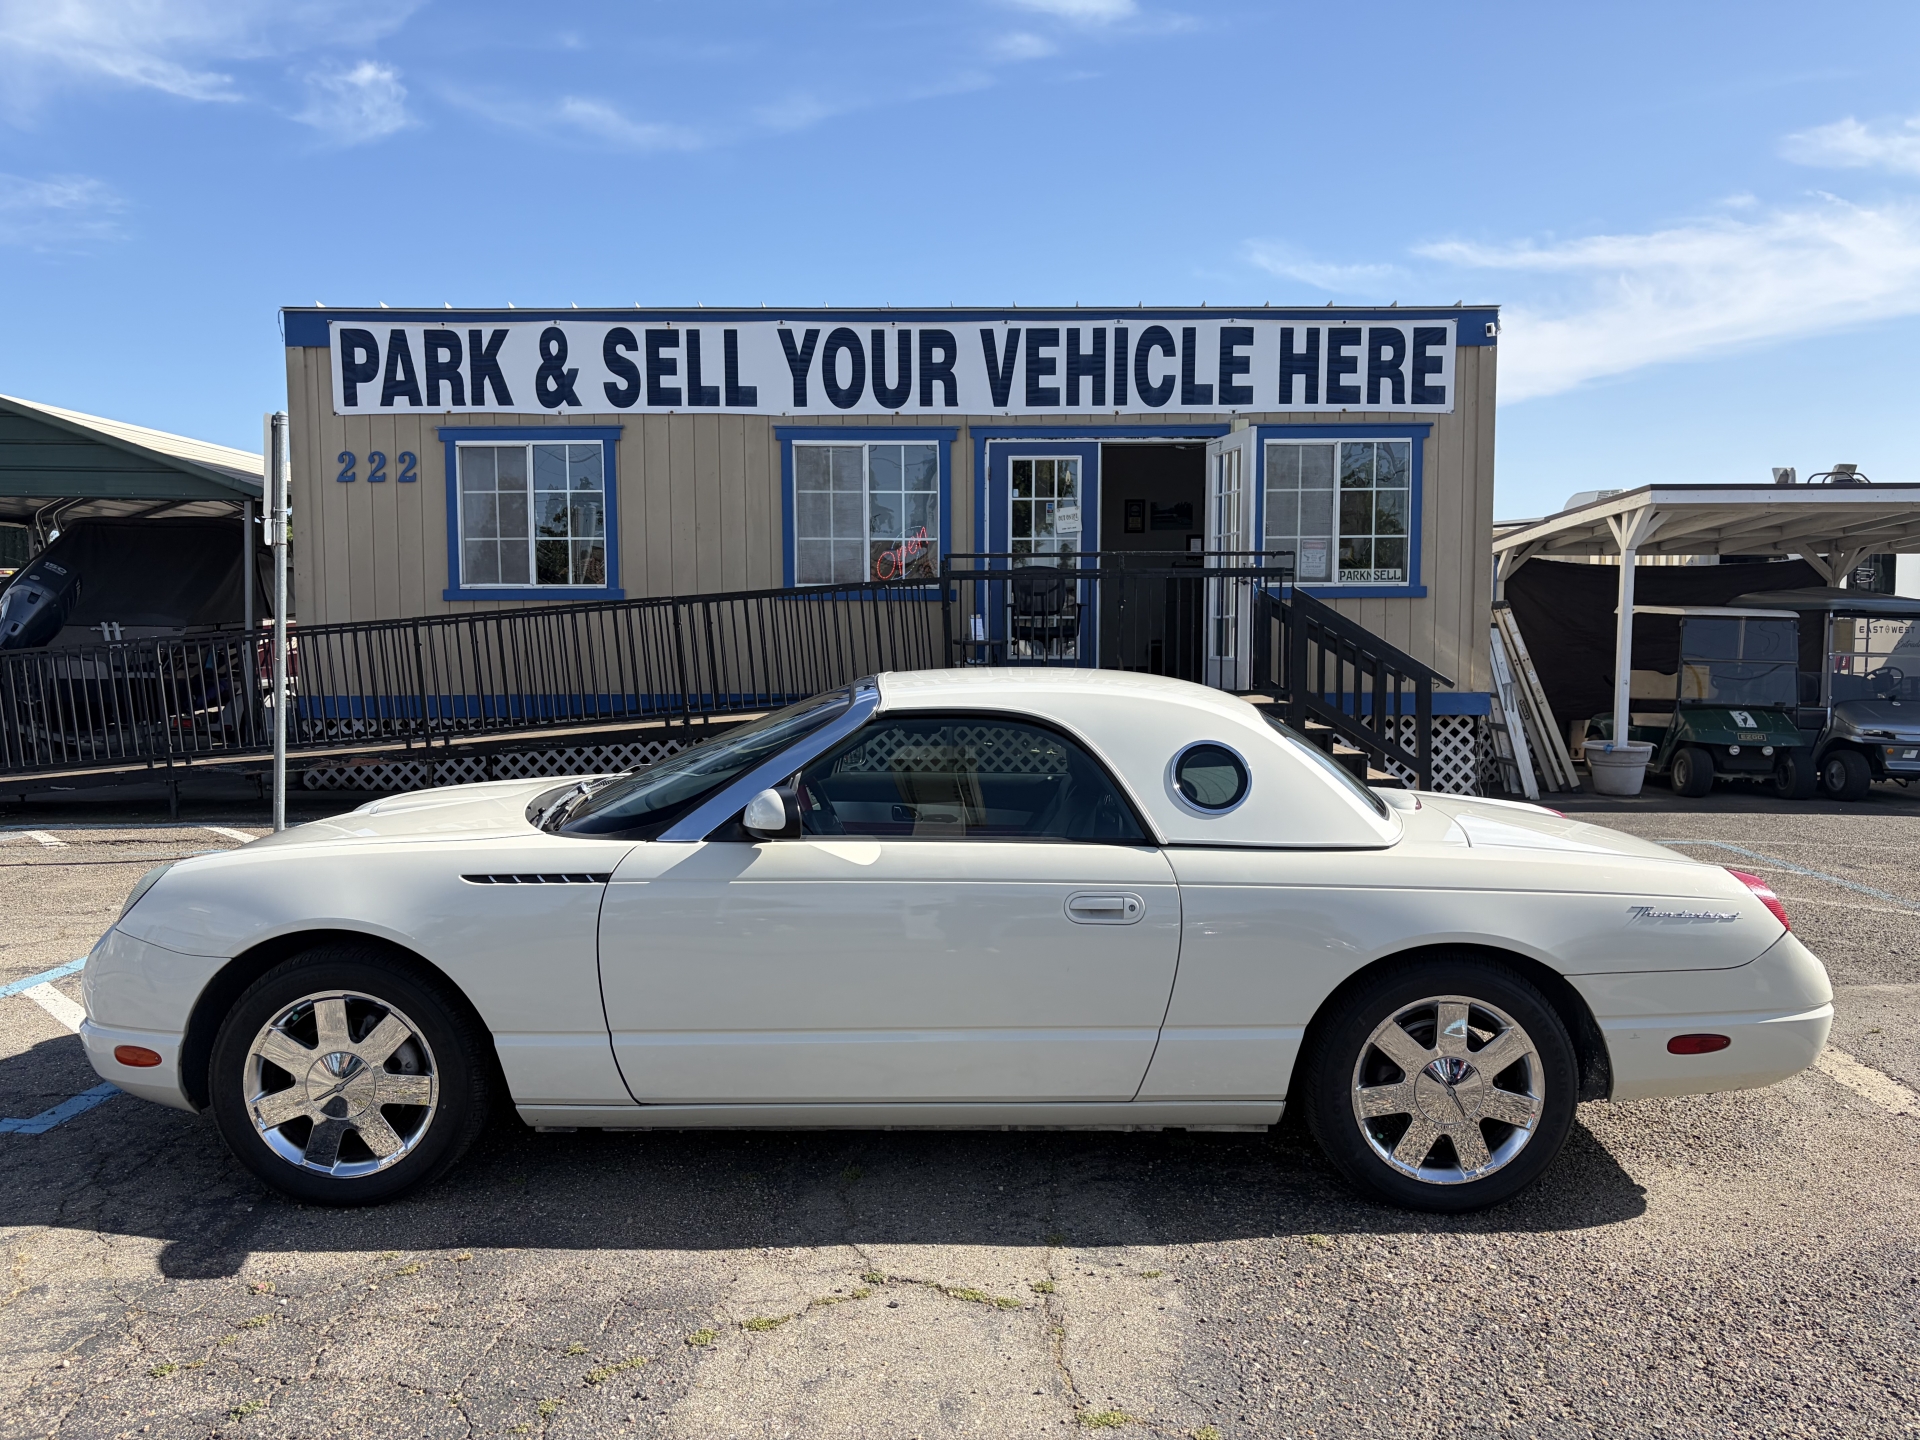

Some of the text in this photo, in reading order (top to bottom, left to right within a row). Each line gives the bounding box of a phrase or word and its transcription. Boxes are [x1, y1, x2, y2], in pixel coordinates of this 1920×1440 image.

[340, 325, 1448, 409] PARK & SELL YOUR VEHICLE HERE
[336, 450, 418, 483] 222
[1891, 625, 1916, 634] WEST
[1627, 905, 1743, 922] Thunderbird
